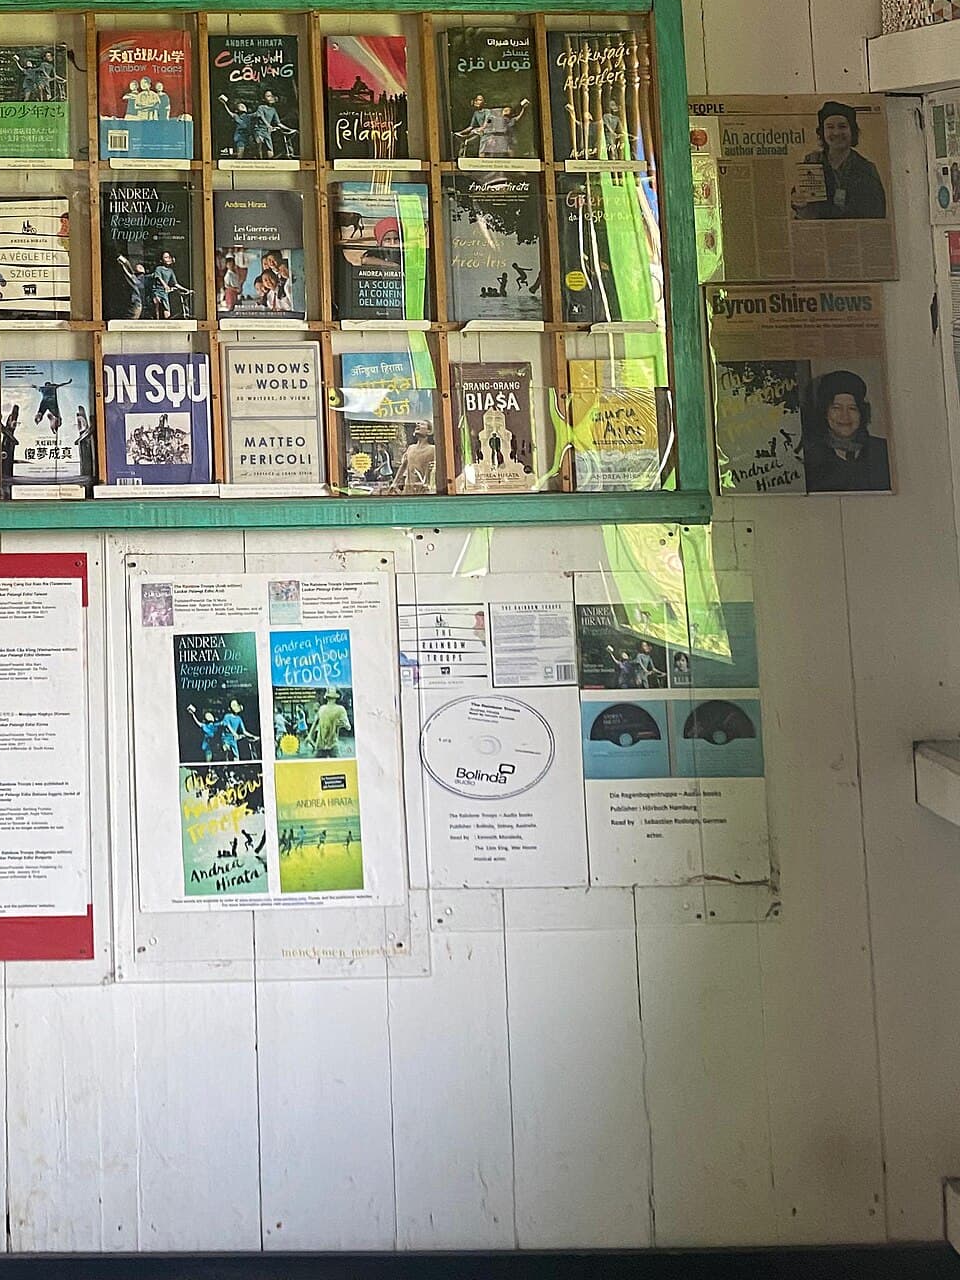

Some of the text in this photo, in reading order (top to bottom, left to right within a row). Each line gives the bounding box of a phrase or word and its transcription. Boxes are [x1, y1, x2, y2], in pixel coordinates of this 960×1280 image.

[458, 58, 530, 72] قوس قزح
[723, 128, 805, 145] An accidental
[724, 146, 788, 155] author abroad
[110, 188, 158, 199] ANDREA
[110, 202, 174, 213] HIRATA Die
[110, 215, 181, 228] Regenbogen-
[111, 228, 149, 241] Truppe
[234, 225, 278, 233] Les Guerriers
[11, 251, 58, 261] VÉGLETEK
[11, 270, 48, 278] SZIGETE
[712, 293, 872, 319] Byron Shire News
[235, 364, 309, 374] WINDOWS
[146, 363, 207, 407] SQU
[256, 379, 308, 389] WORLD
[245, 437, 305, 447] MATTEO
[240, 455, 312, 464] PERICOLI
[757, 472, 800, 491] Hirata
[178, 636, 225, 648] ANDREA
[274, 632, 348, 653] andrea hirata
[179, 650, 240, 661] HIRATA Die
[275, 648, 348, 666] the rainbow
[180, 663, 248, 676] Regenbogen-
[285, 662, 341, 685] troops
[181, 677, 217, 690] Truppe
[456, 768, 507, 784] Bolinda
[297, 798, 352, 808] ANDREA HIRATA
[190, 860, 244, 882] Andrea
[216, 871, 260, 891] Hirata
